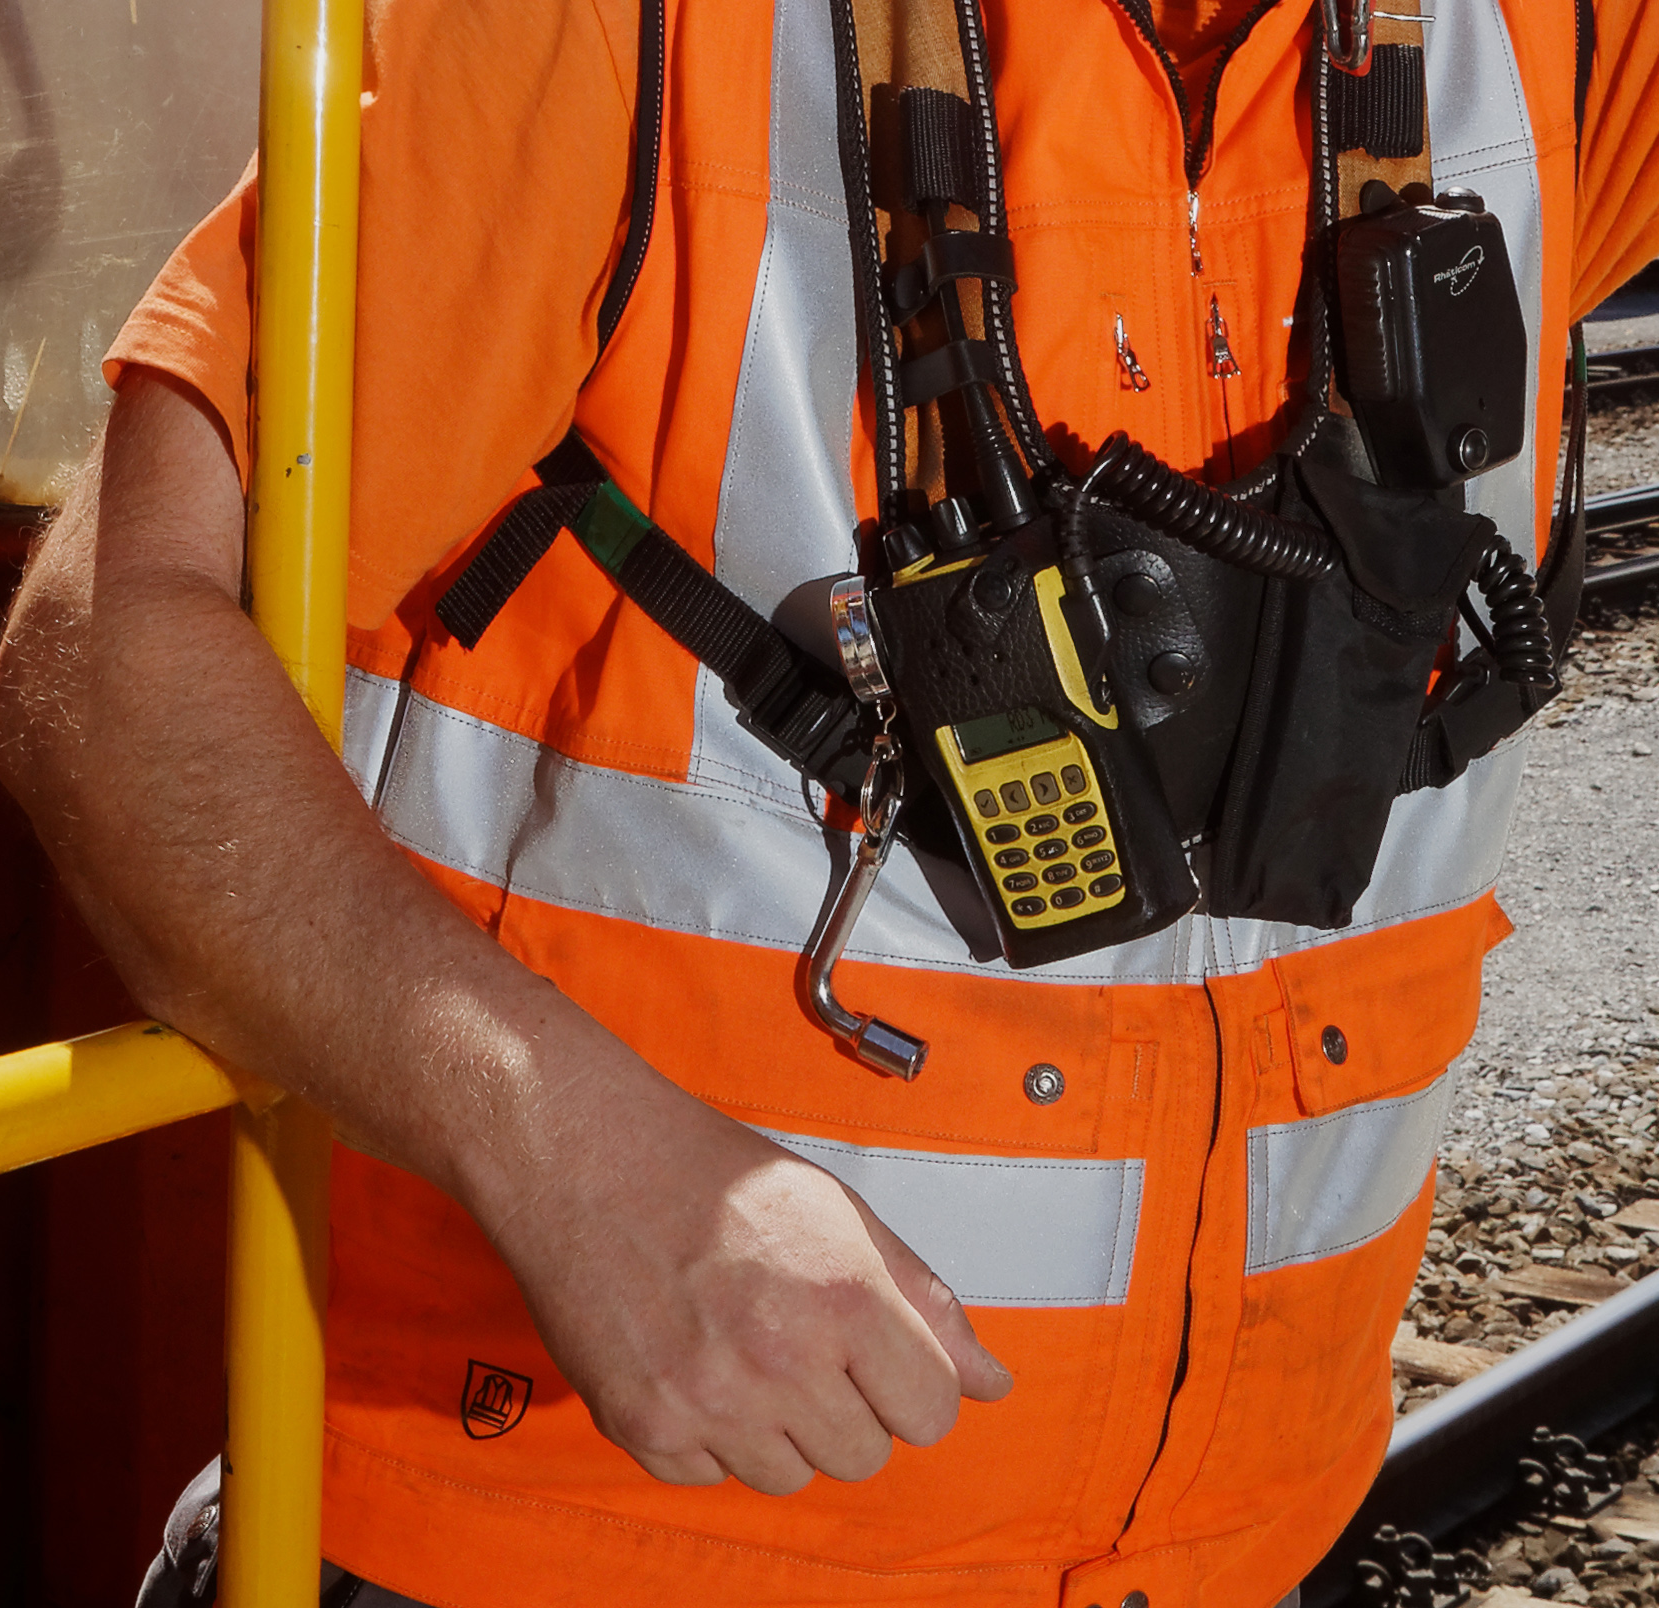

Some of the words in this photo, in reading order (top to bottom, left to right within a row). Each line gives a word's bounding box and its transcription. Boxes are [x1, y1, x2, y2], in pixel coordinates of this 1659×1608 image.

[1068, 813, 1075, 821] 3
[1031, 823, 1038, 832] 2
[1077, 837, 1084, 845] 6
[1039, 847, 1046, 857] 5
[1000, 856, 1006, 864] 4
[1086, 859, 1093, 869] 9
[1047, 872, 1055, 881] 8
[1009, 879, 1015, 888] 7
[1055, 896, 1063, 905] 0
